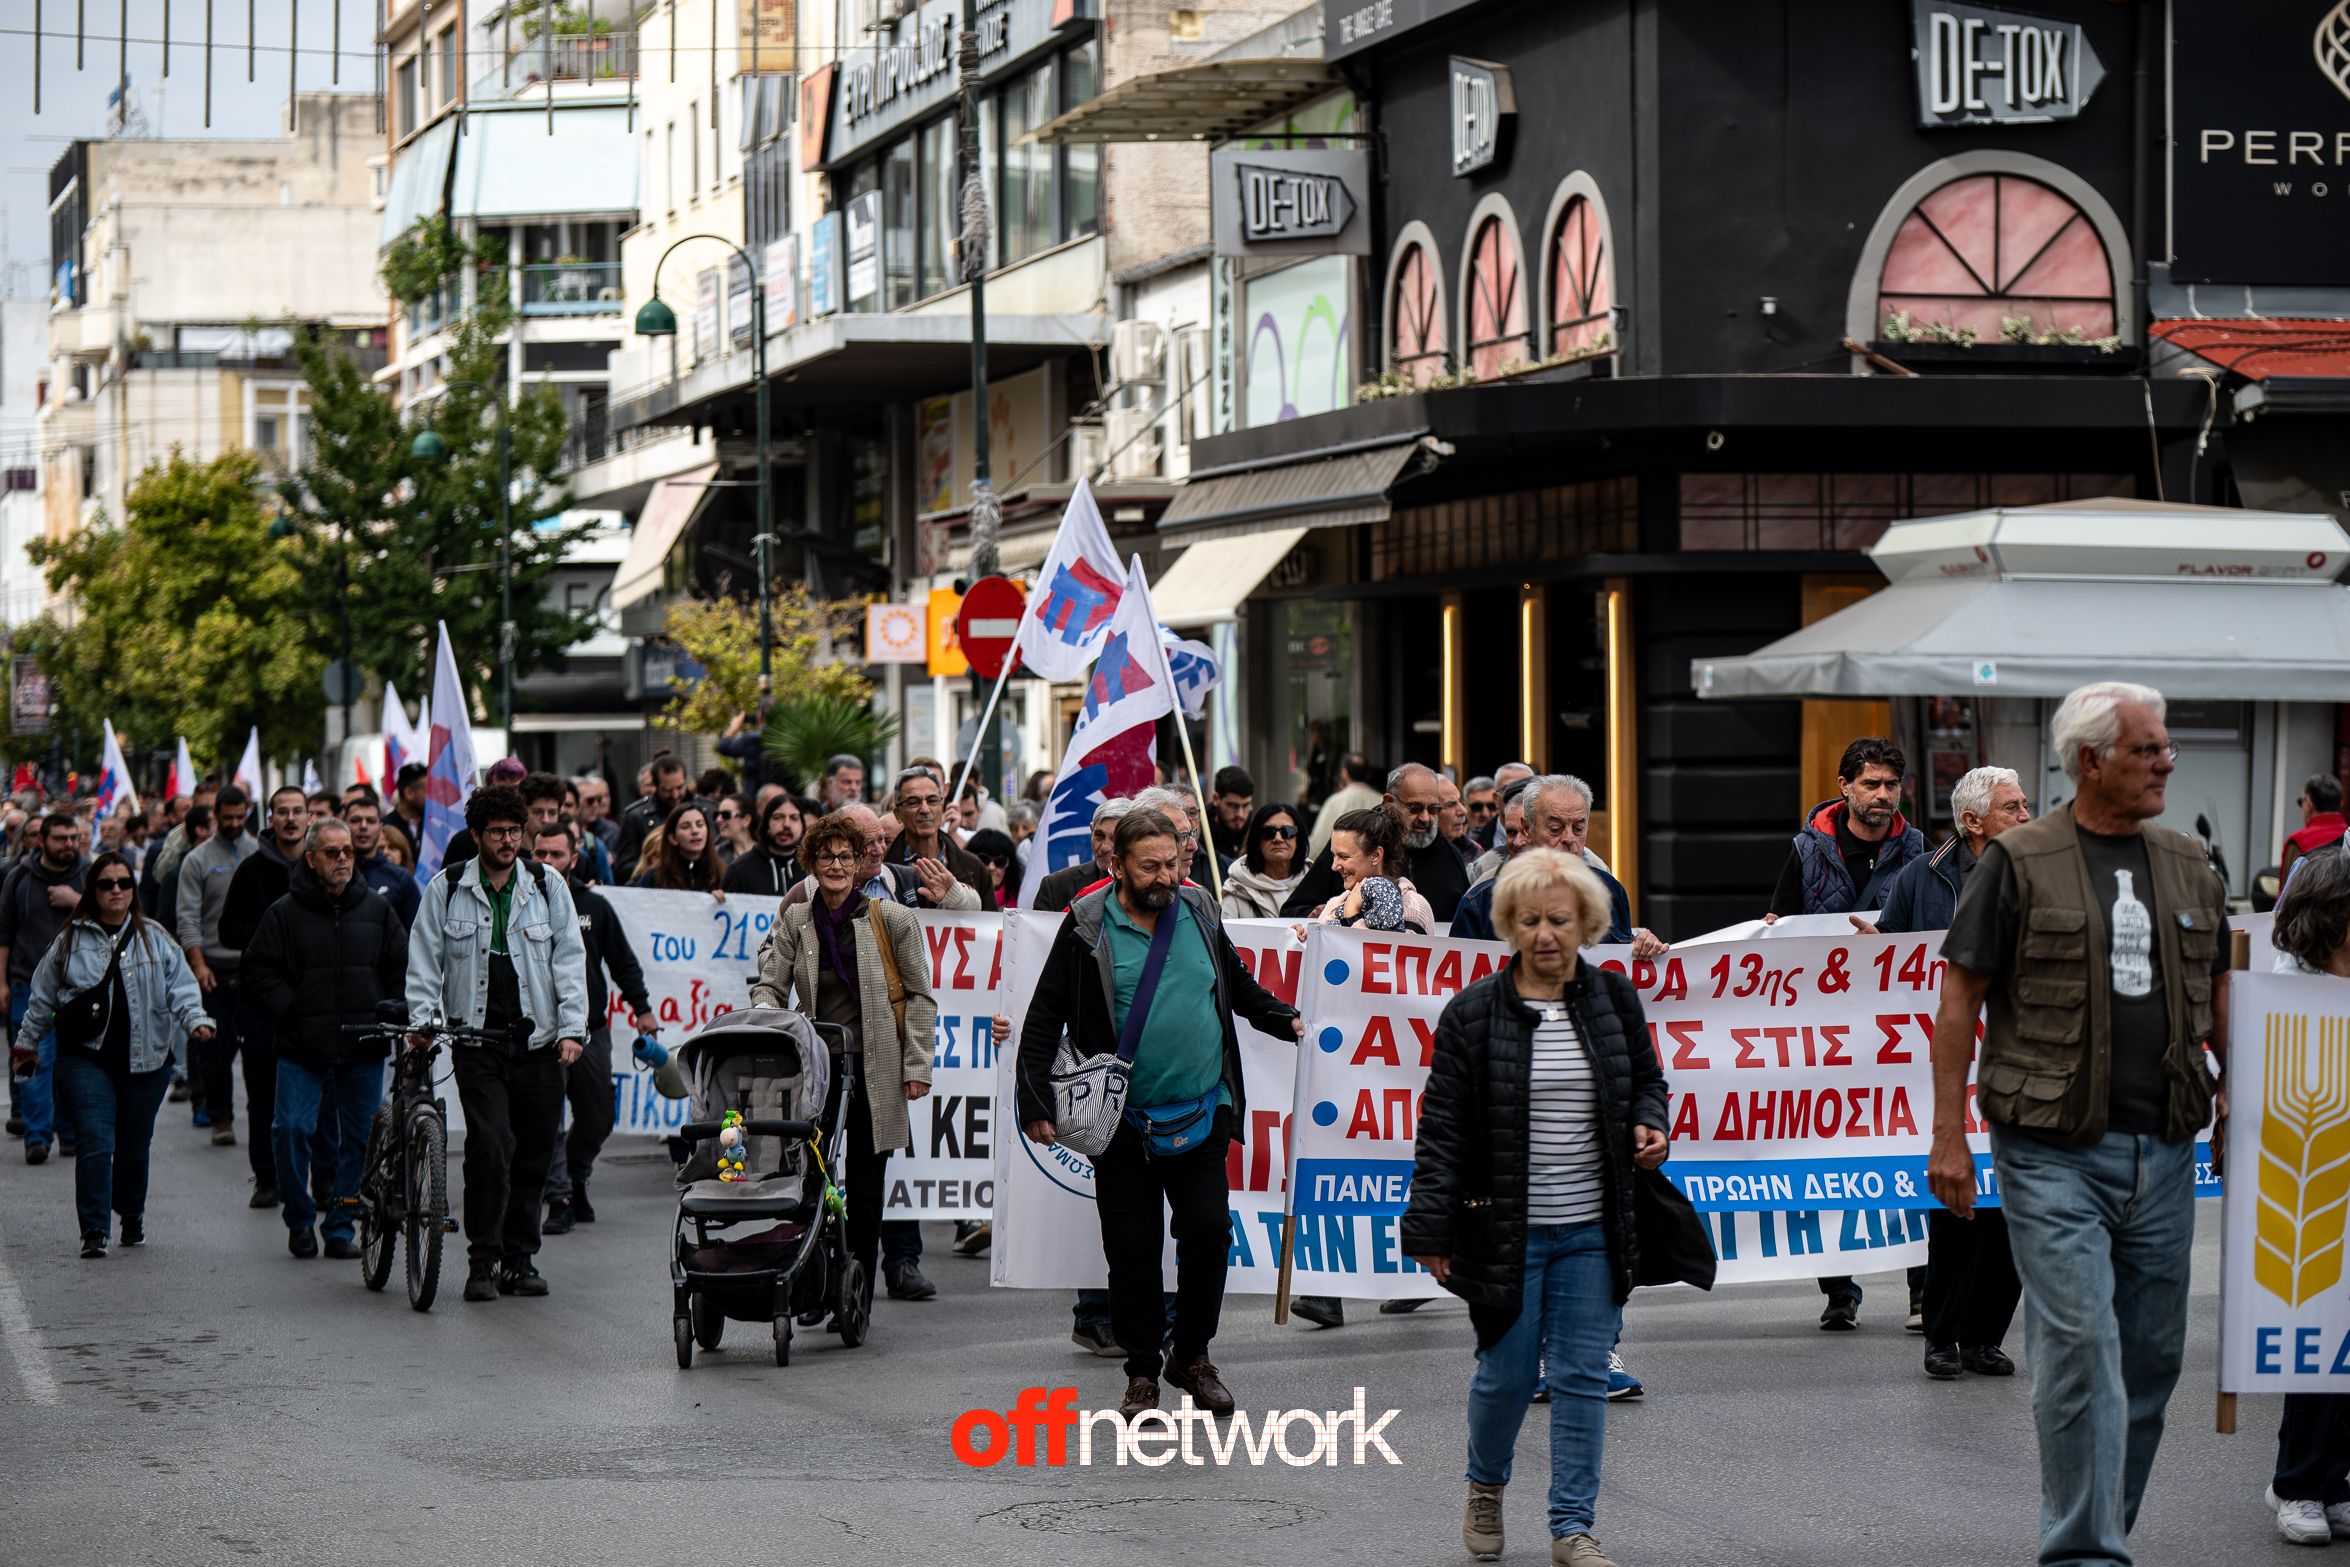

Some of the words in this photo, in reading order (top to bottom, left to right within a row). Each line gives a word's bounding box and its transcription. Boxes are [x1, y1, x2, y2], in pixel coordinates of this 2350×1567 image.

[1930, 13, 2064, 113] DE-TOX
[1250, 172, 1330, 231] DE-TOX
[2273, 182, 2350, 197] WO
[651, 933, 696, 961] του
[1711, 952, 1804, 1006] 13ης
[1817, 948, 1851, 994] &
[1874, 943, 1948, 1001] 14η
[1730, 1025, 1852, 1069] ΣΤΙΣ
[1713, 1086, 1918, 1141] ΔΗΜΟΣΙΑ
[1685, 1174, 1793, 1202] ΠΡΩΗΝ
[1804, 1171, 1884, 1200] ΔΕΚΟ
[1895, 1170, 1918, 1198] &
